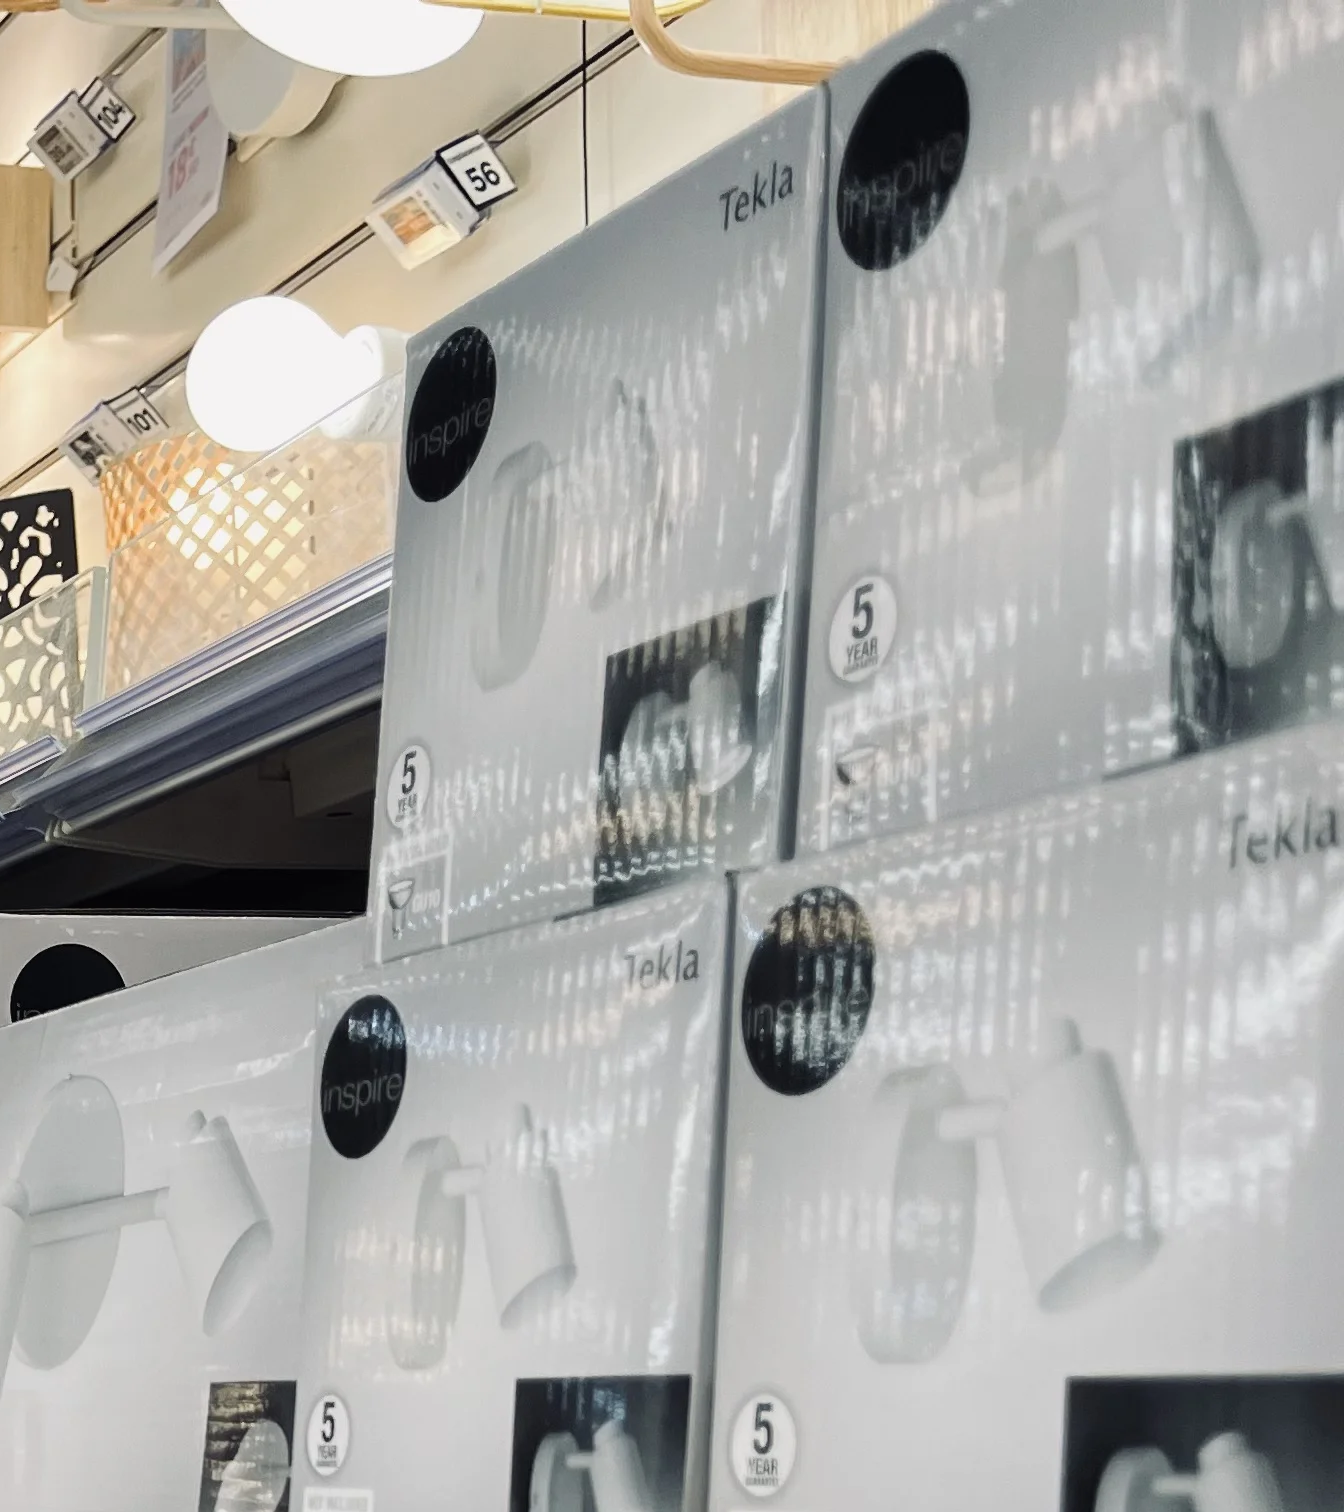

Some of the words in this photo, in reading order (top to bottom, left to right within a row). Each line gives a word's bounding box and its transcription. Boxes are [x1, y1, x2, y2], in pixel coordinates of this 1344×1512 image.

[465, 161, 500, 192] 56
[718, 159, 795, 232] Tekla
[127, 408, 159, 435] 101
[408, 398, 492, 468] inspire
[851, 583, 874, 640] 5
[846, 636, 879, 664] YEAR
[401, 750, 417, 795] 5
[623, 940, 700, 991] Tekla
[321, 1066, 402, 1116] inspire
[321, 1401, 335, 1442] 5
[752, 1402, 774, 1455] 5
[745, 1457, 779, 1475] YEAR
